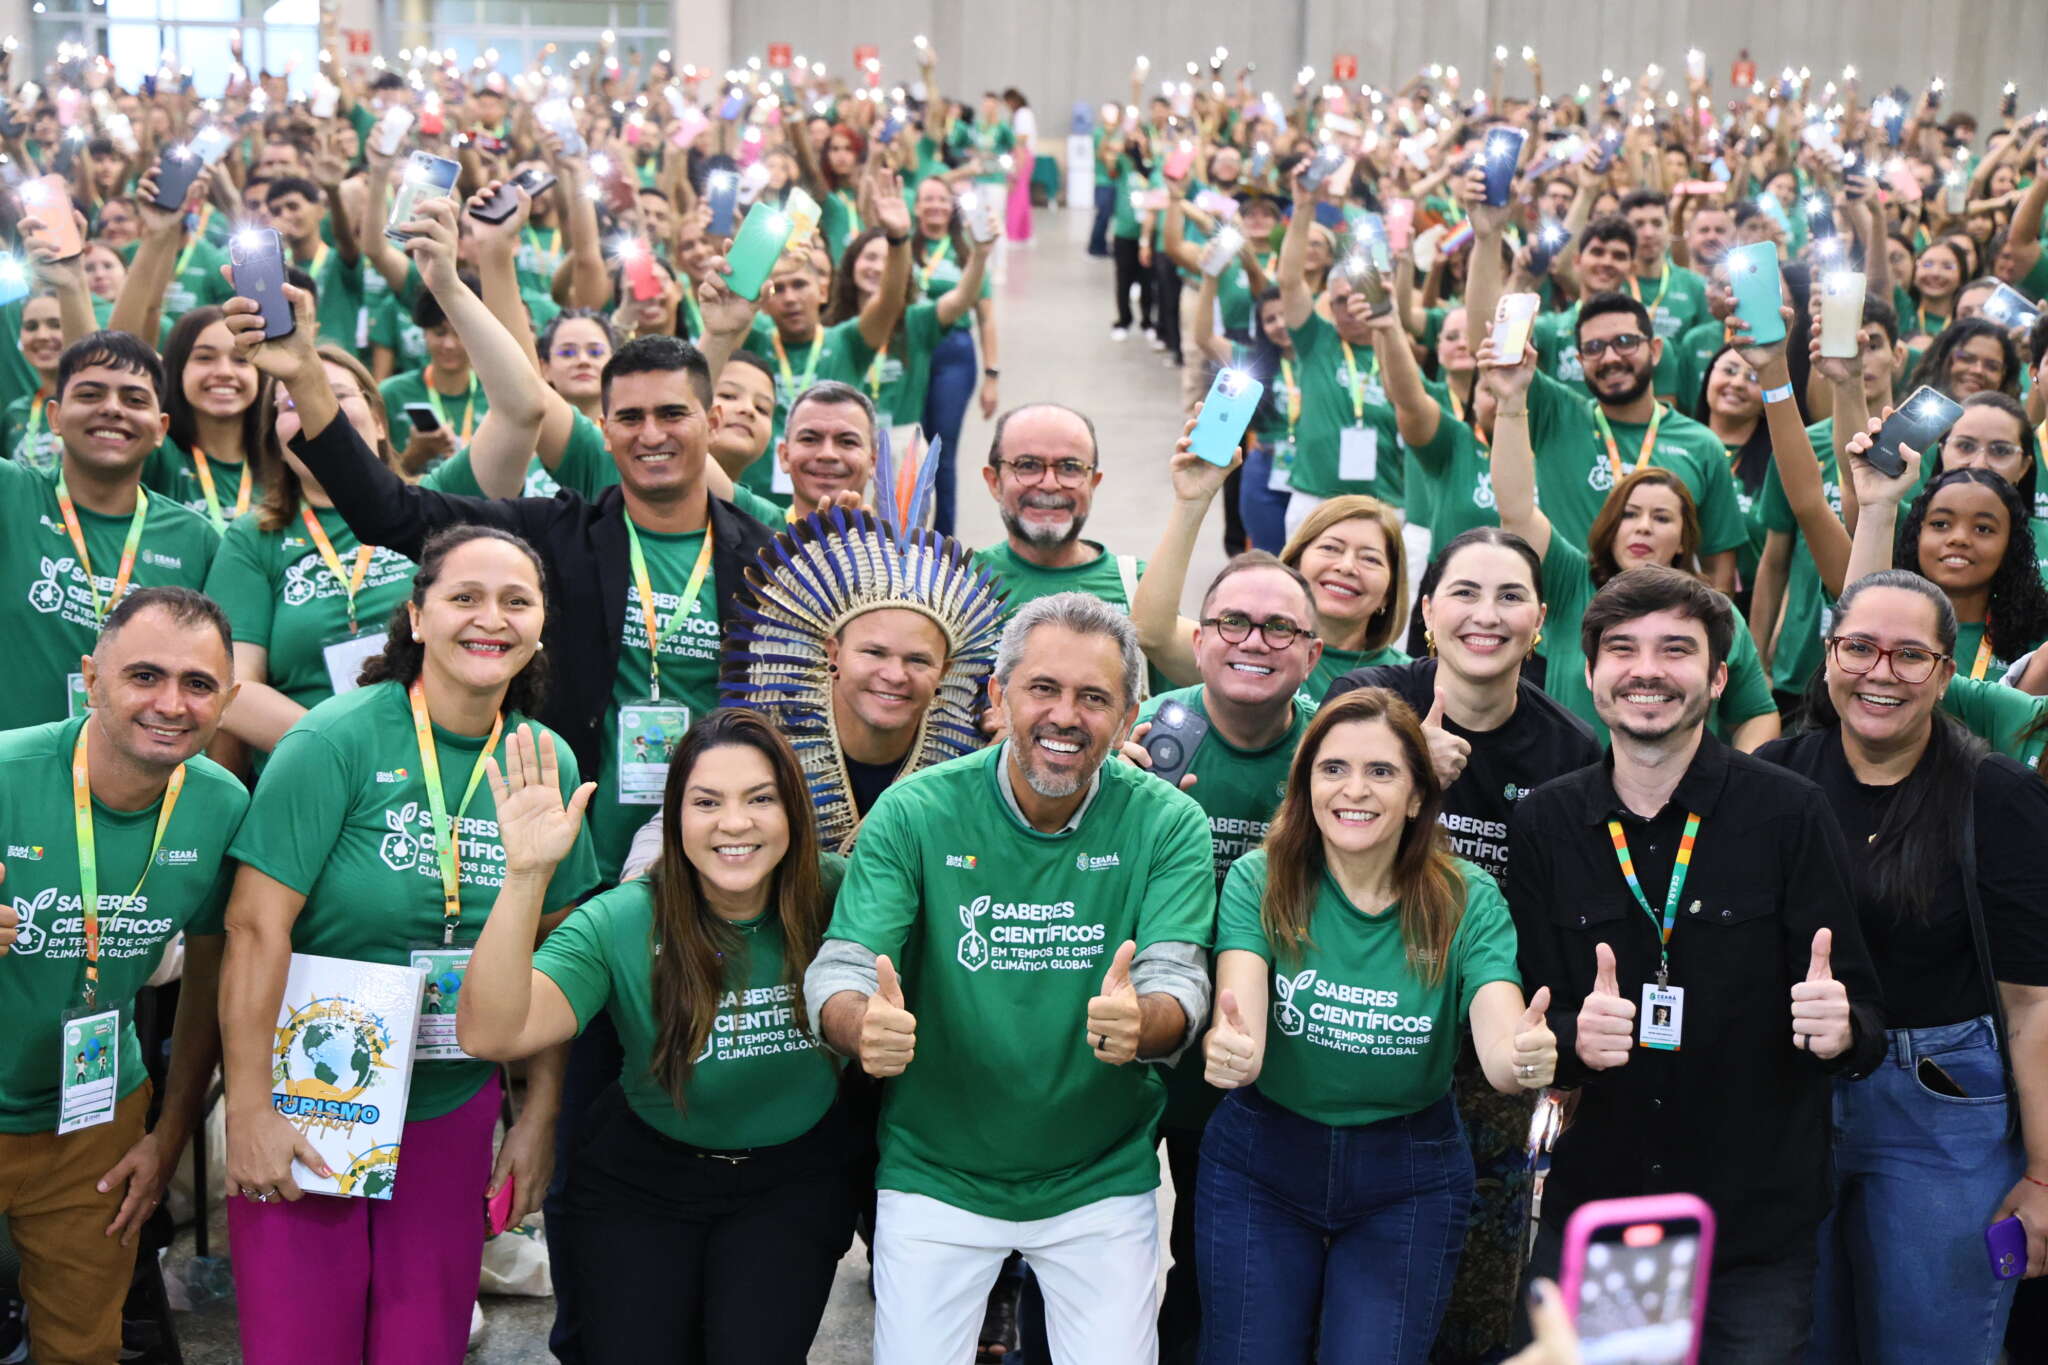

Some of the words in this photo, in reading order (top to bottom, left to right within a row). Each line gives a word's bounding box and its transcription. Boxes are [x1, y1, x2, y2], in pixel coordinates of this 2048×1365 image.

[674, 646, 715, 660] GLOBAL
[680, 635, 695, 646] DE
[696, 637, 720, 650] CRIS
[418, 811, 499, 838] SBERES
[1207, 816, 1270, 838] ABERES
[1436, 812, 1507, 839] ABERES
[169, 848, 198, 859] CEARÁ
[418, 853, 434, 865] EM
[481, 864, 497, 875] DE
[1090, 851, 1120, 865] CEARÁ
[1666, 875, 1680, 905] CEARÁ
[56, 895, 149, 912] SAERES
[991, 901, 1075, 921] SABERES
[48, 937, 65, 947] EM
[117, 937, 132, 947] DE
[990, 922, 1105, 945] CIENTÍFICOS
[45, 947, 106, 959] CLIMÁTA
[108, 947, 150, 959] GLOBAL
[991, 947, 1007, 957] EM
[1011, 947, 1053, 959] TEMPOS
[1056, 947, 1070, 957] DE
[1072, 944, 1104, 957] CRISE
[991, 958, 1048, 972] CLIMÁTICA
[1051, 958, 1093, 970] GLOBAL
[1314, 979, 1399, 1008] SABERES
[713, 1004, 797, 1033] CIENTÍFI
[1309, 1002, 1433, 1033] CIENTÍFICOS
[717, 1036, 733, 1048] EM
[737, 1030, 785, 1046] TEMPOS
[1308, 1023, 1324, 1035] EM
[1327, 1026, 1374, 1044] TEMPOS
[1378, 1035, 1393, 1045] DE
[1396, 1034, 1432, 1045] CRISE
[717, 1044, 781, 1060] CLIMÁTICA
[1307, 1034, 1368, 1055] CLIMÁTICA
[1371, 1047, 1419, 1056] GLOBAL
[272, 1093, 381, 1126] TURISMO
